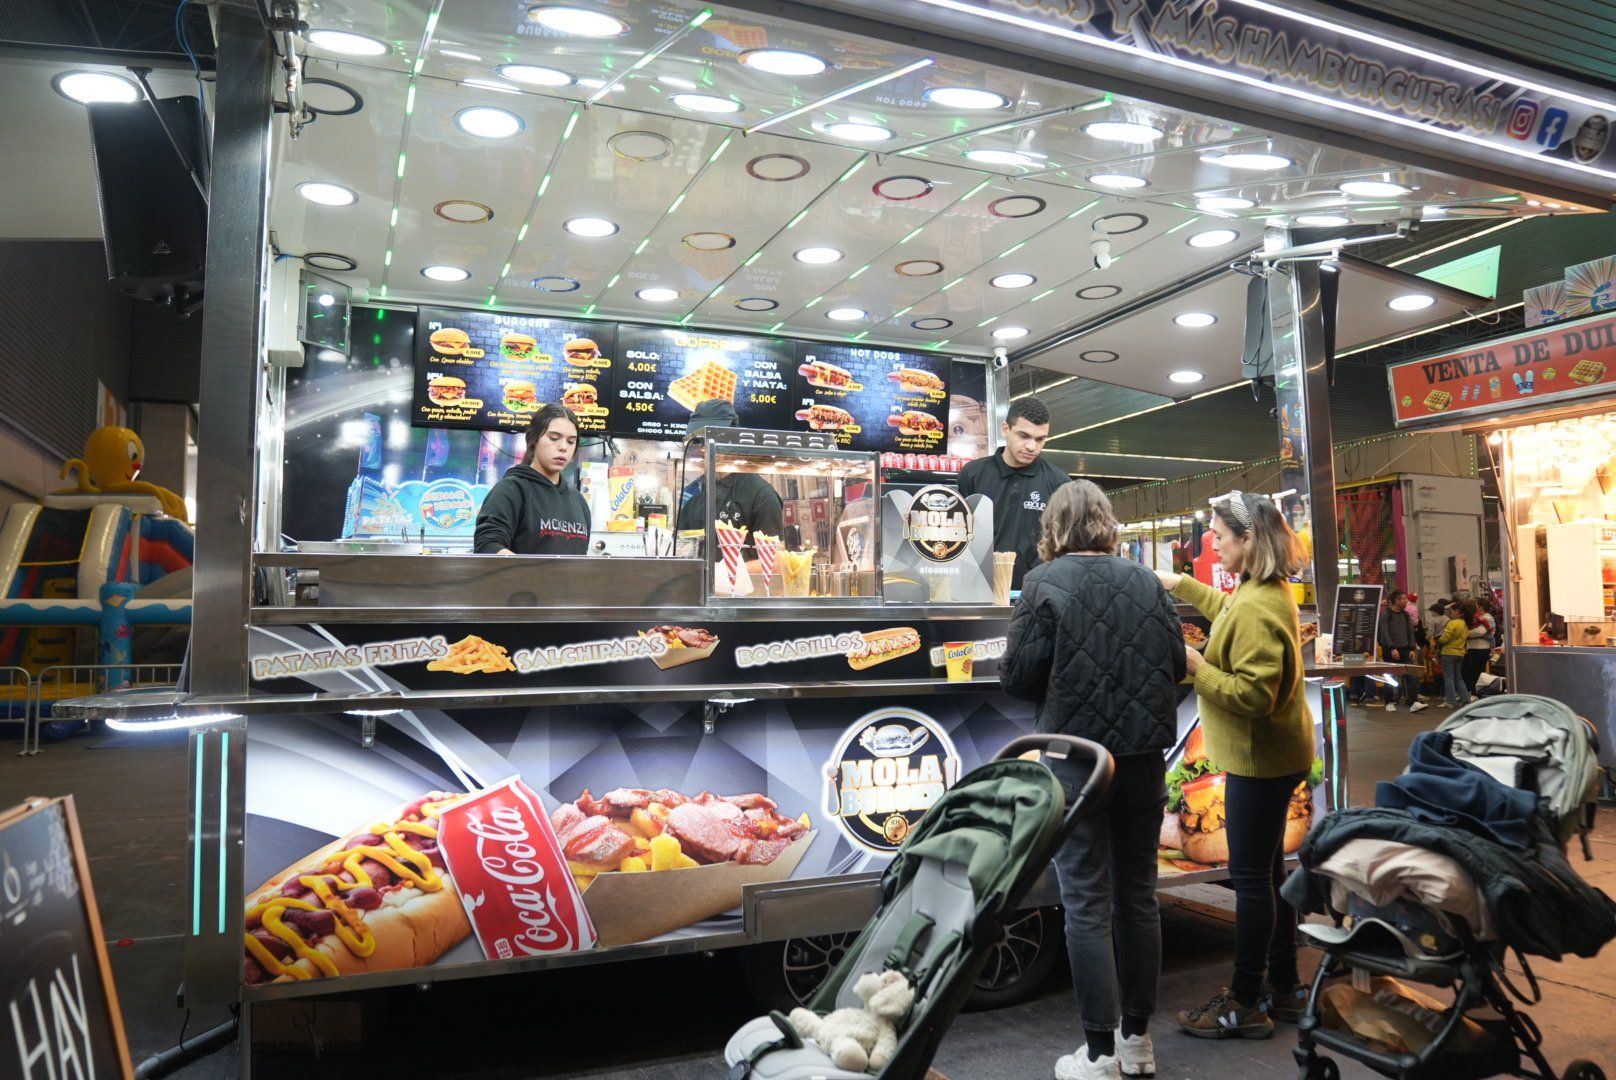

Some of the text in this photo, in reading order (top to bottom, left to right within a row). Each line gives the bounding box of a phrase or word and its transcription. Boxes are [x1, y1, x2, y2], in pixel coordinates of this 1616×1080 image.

[1151, 1, 1238, 62] MÁS
[1237, 25, 1502, 133] HAMBURGUESAS!
[626, 350, 660, 361] SOLO:
[851, 349, 900, 360] HOT DOGS
[628, 362, 657, 372] 4,00€
[753, 361, 777, 370] CON
[1421, 351, 1502, 385] VENTA
[1512, 338, 1550, 366] DE
[744, 370, 782, 380] SALSA
[627, 381, 653, 390] CON
[742, 379, 787, 389] Y NATA:
[619, 390, 664, 400] SALSA:
[750, 394, 777, 404] 5,00€
[625, 402, 654, 412] 4,50€
[611, 478, 634, 512] ColaCao
[910, 510, 966, 528] MOLA
[515, 636, 666, 671] SALCHIPAPAS
[738, 633, 865, 665] BOCADILLOS
[254, 638, 448, 678] PATATAS FRITAS
[840, 754, 944, 790] MOLA
[9, 952, 95, 1080] HAY
